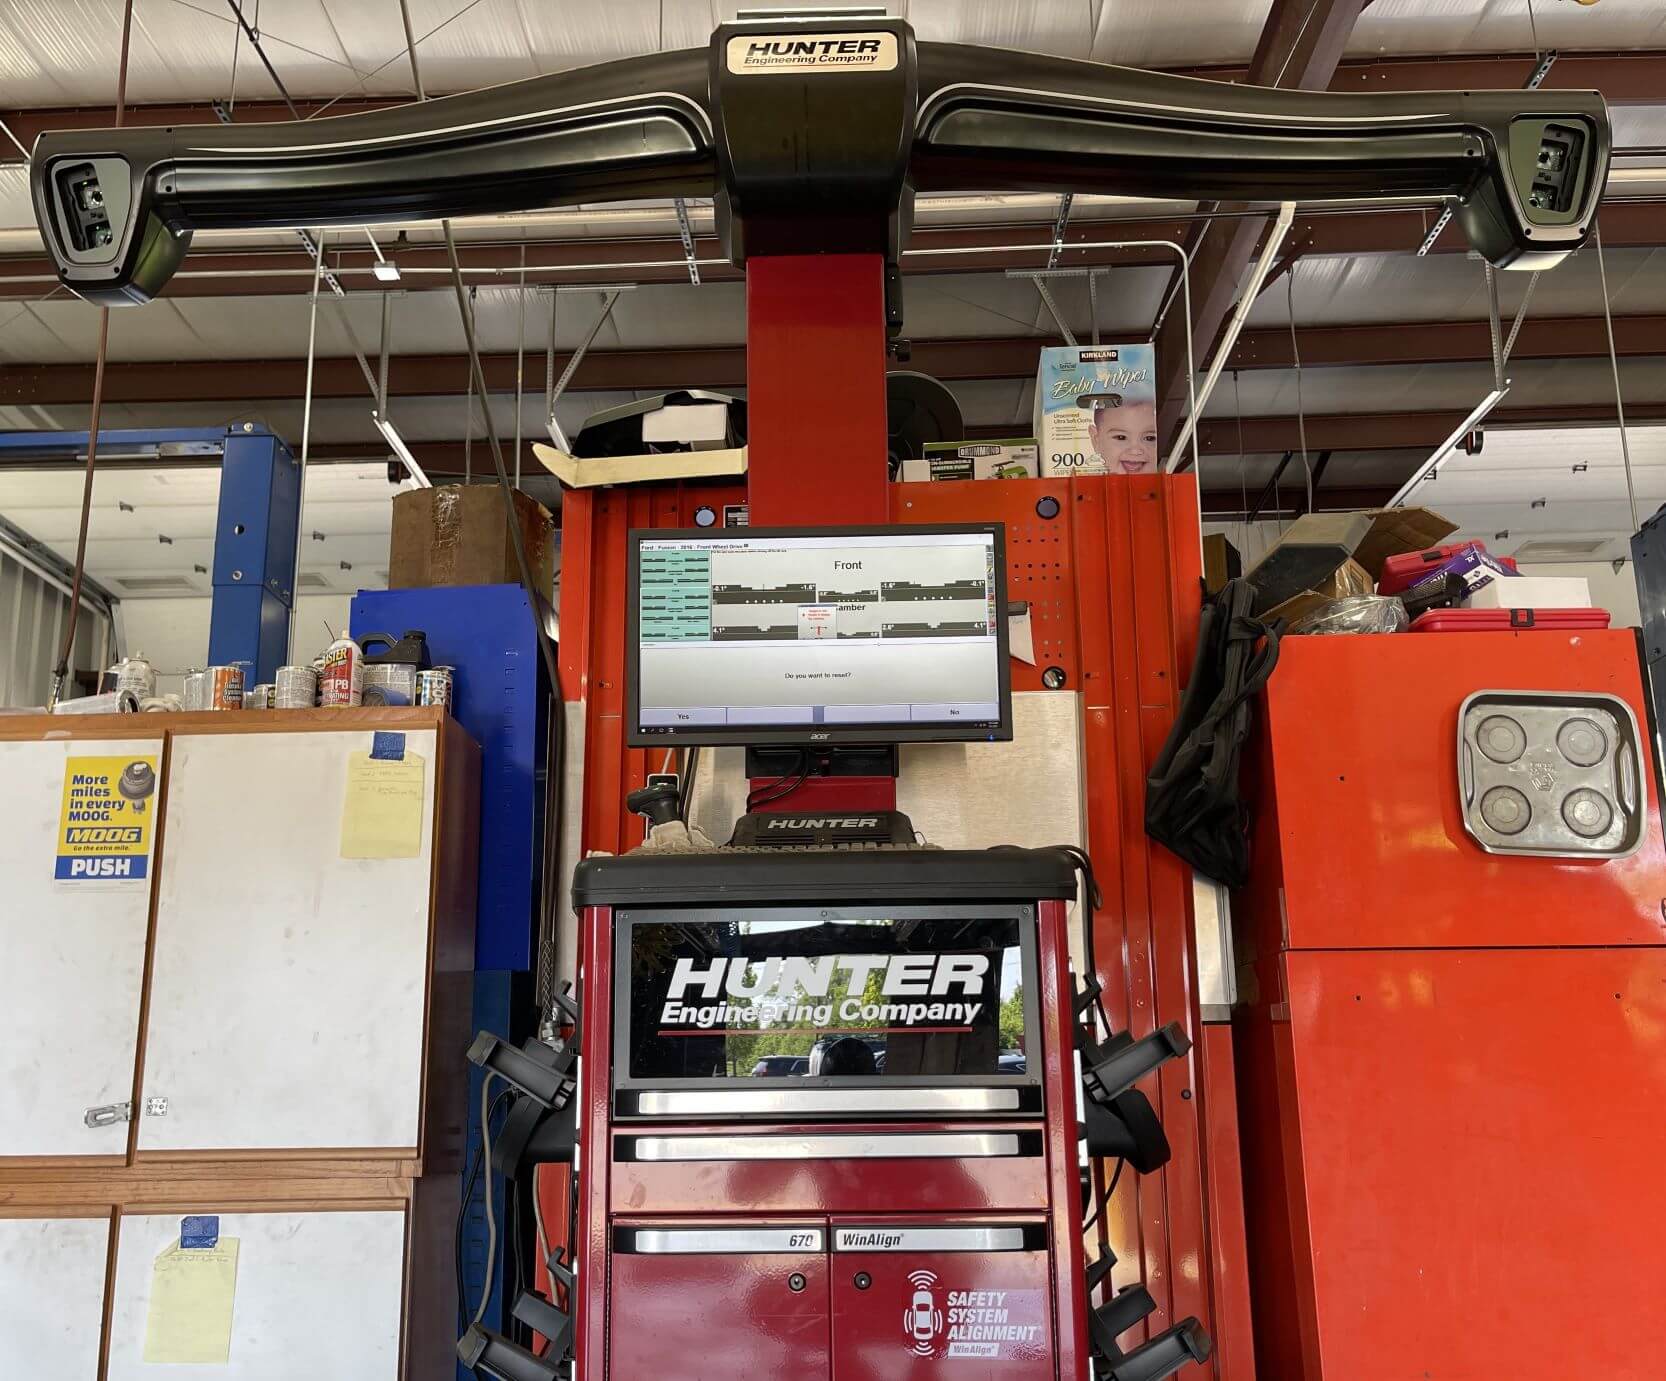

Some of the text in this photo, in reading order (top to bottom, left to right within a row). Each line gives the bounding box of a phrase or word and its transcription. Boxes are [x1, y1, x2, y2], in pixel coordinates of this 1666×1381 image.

[747, 40, 881, 56] HUNTER
[744, 54, 877, 66] Engineering Company
[1081, 351, 1117, 359] KIRKLAND
[1052, 367, 1147, 399] Baby Wipes
[960, 446, 1000, 456] DRUMMOND
[1051, 452, 1085, 468] 900
[834, 561, 863, 570] Front
[810, 732, 830, 741] acer
[73, 775, 108, 785] More
[71, 786, 111, 797] miles
[70, 799, 125, 812] in every
[767, 819, 878, 829] HUNTER
[68, 829, 140, 842] MOOG
[71, 858, 131, 876] PUSH
[666, 954, 989, 999] HUNTER
[659, 999, 983, 1029] Engineering Company
[946, 1291, 1008, 1307] SAFETY
[947, 1308, 1009, 1324] SYSTEM
[946, 1325, 1038, 1341] ALIGNMENT
